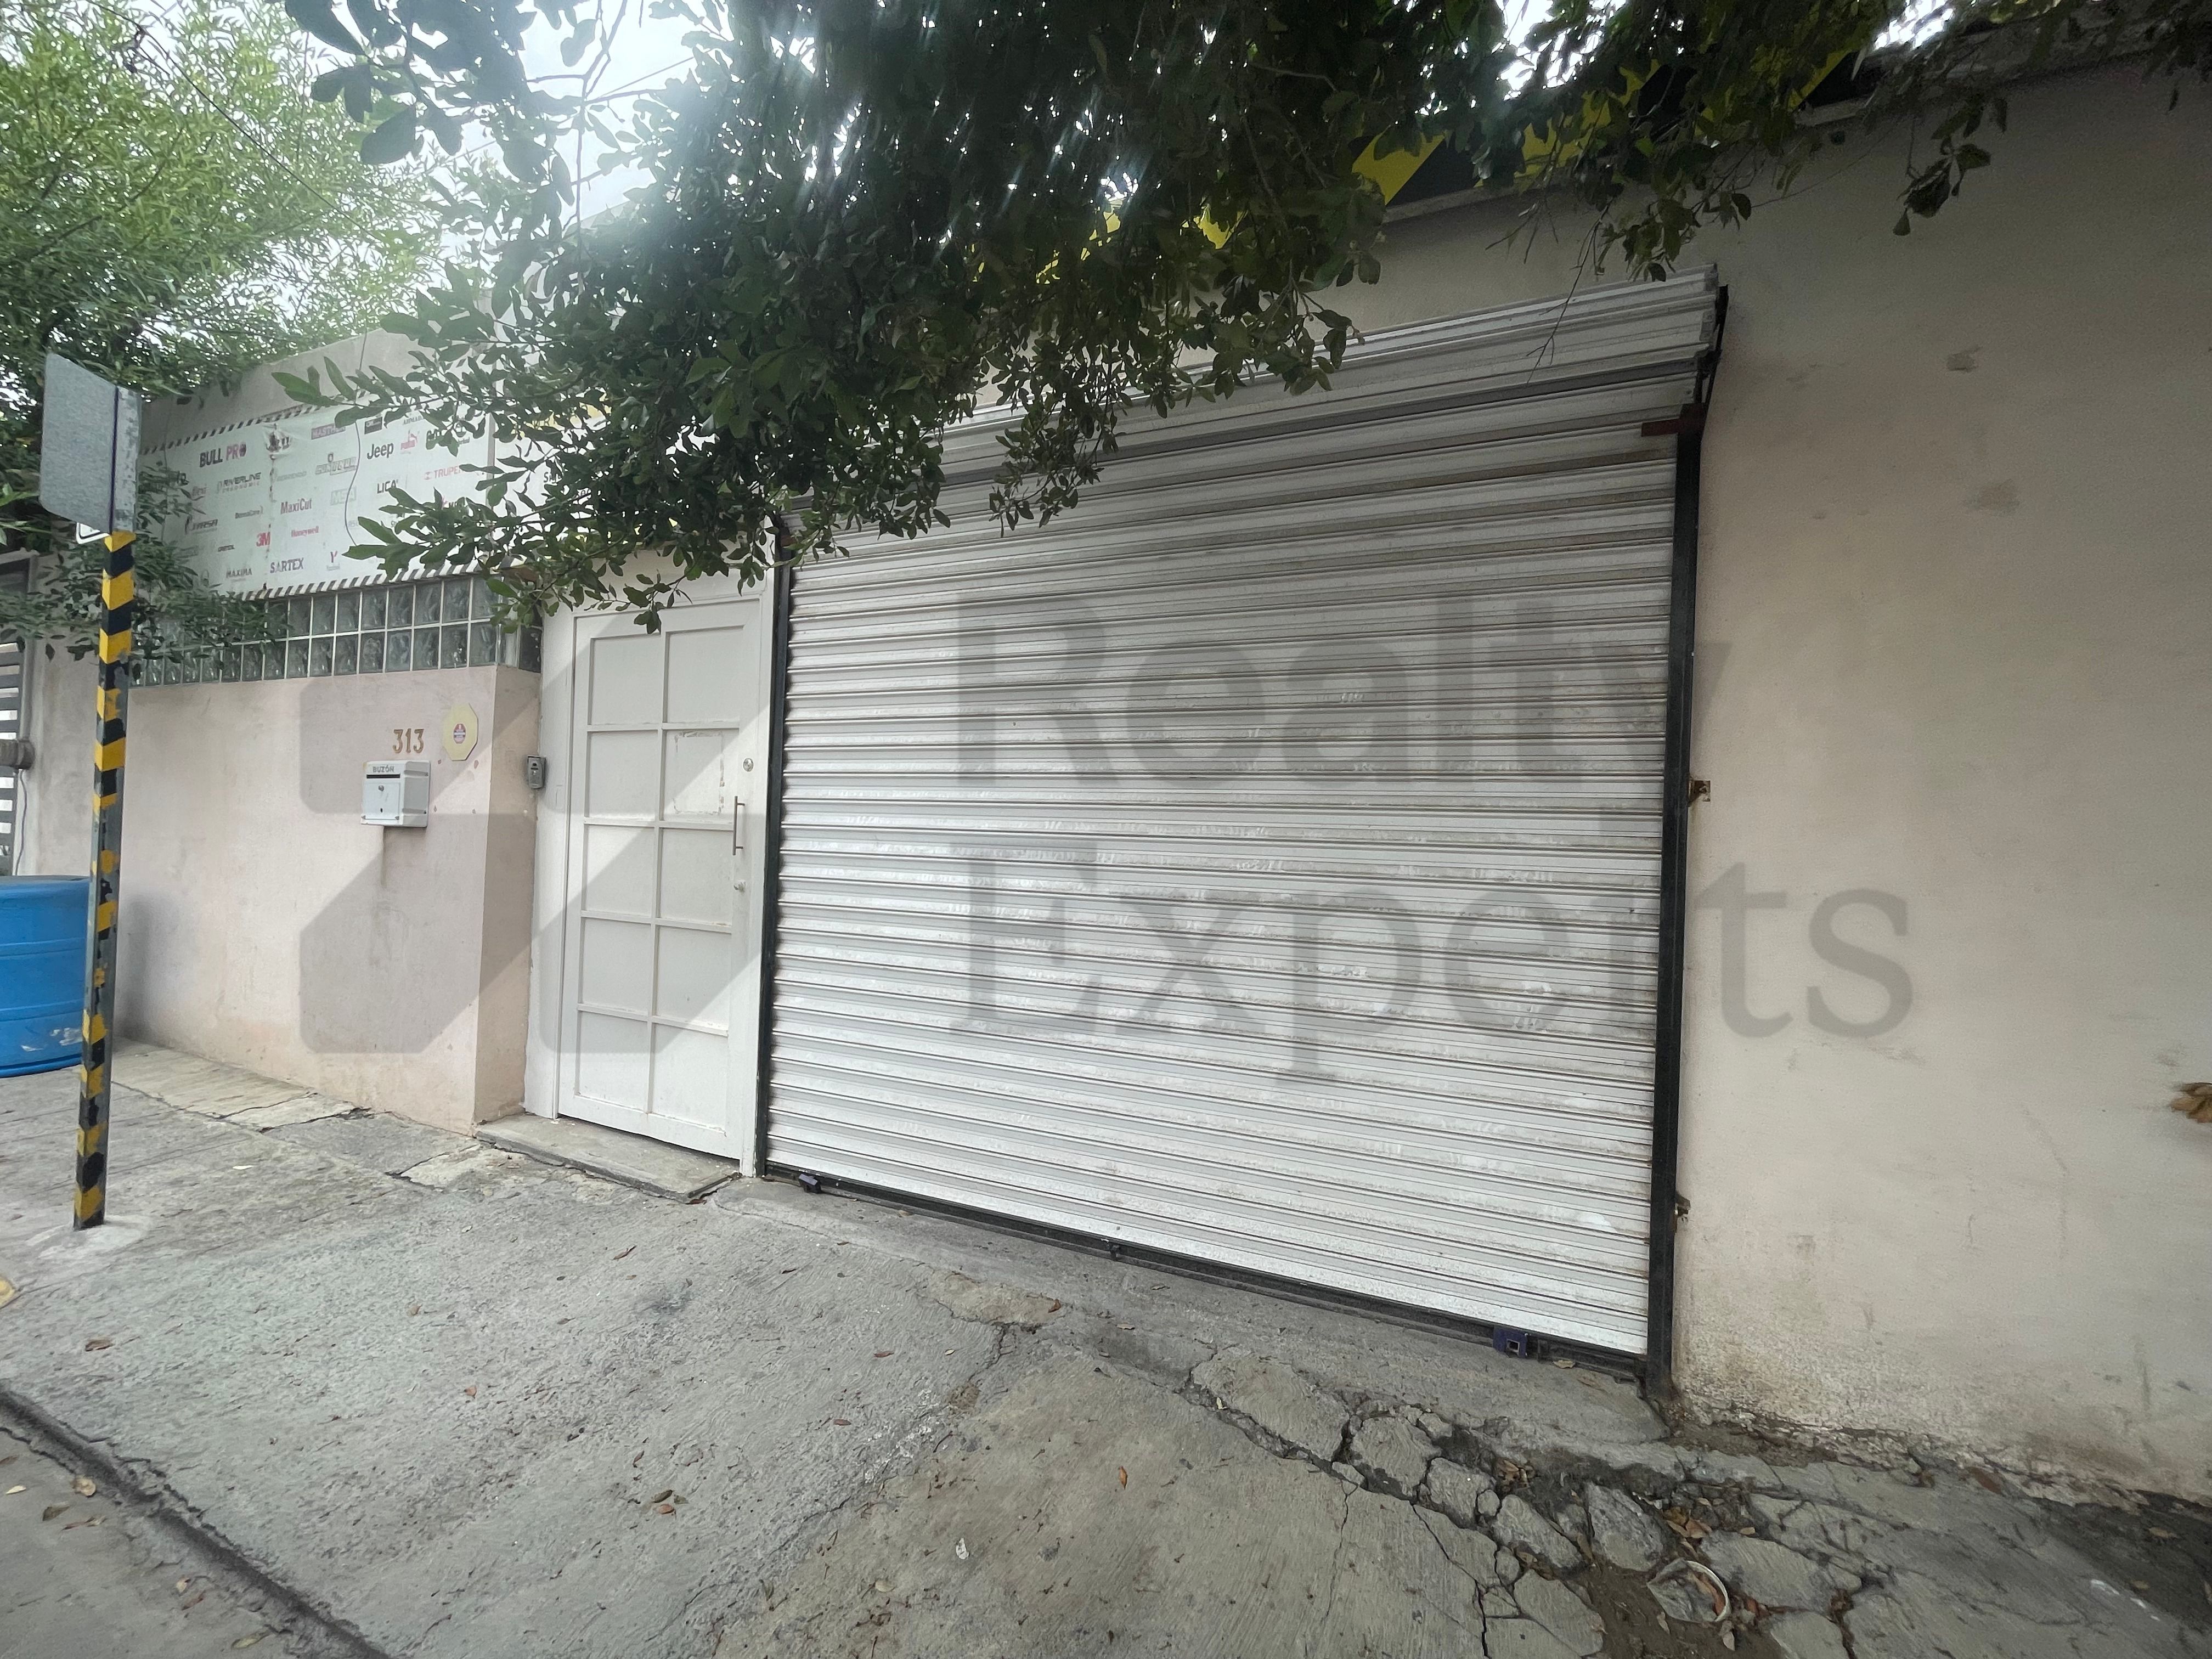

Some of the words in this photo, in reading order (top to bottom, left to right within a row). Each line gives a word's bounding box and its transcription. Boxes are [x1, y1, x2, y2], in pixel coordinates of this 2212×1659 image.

[200, 448, 223, 467] BULL
[367, 443, 394, 460] Jeep
[435, 466, 462, 479] TRUPE
[280, 498, 312, 515] MaxiCut
[256, 531, 271, 547] 3M
[270, 557, 304, 574] SARTEX
[393, 728, 425, 754] 313
[372, 764, 394, 773] BUZÓN
